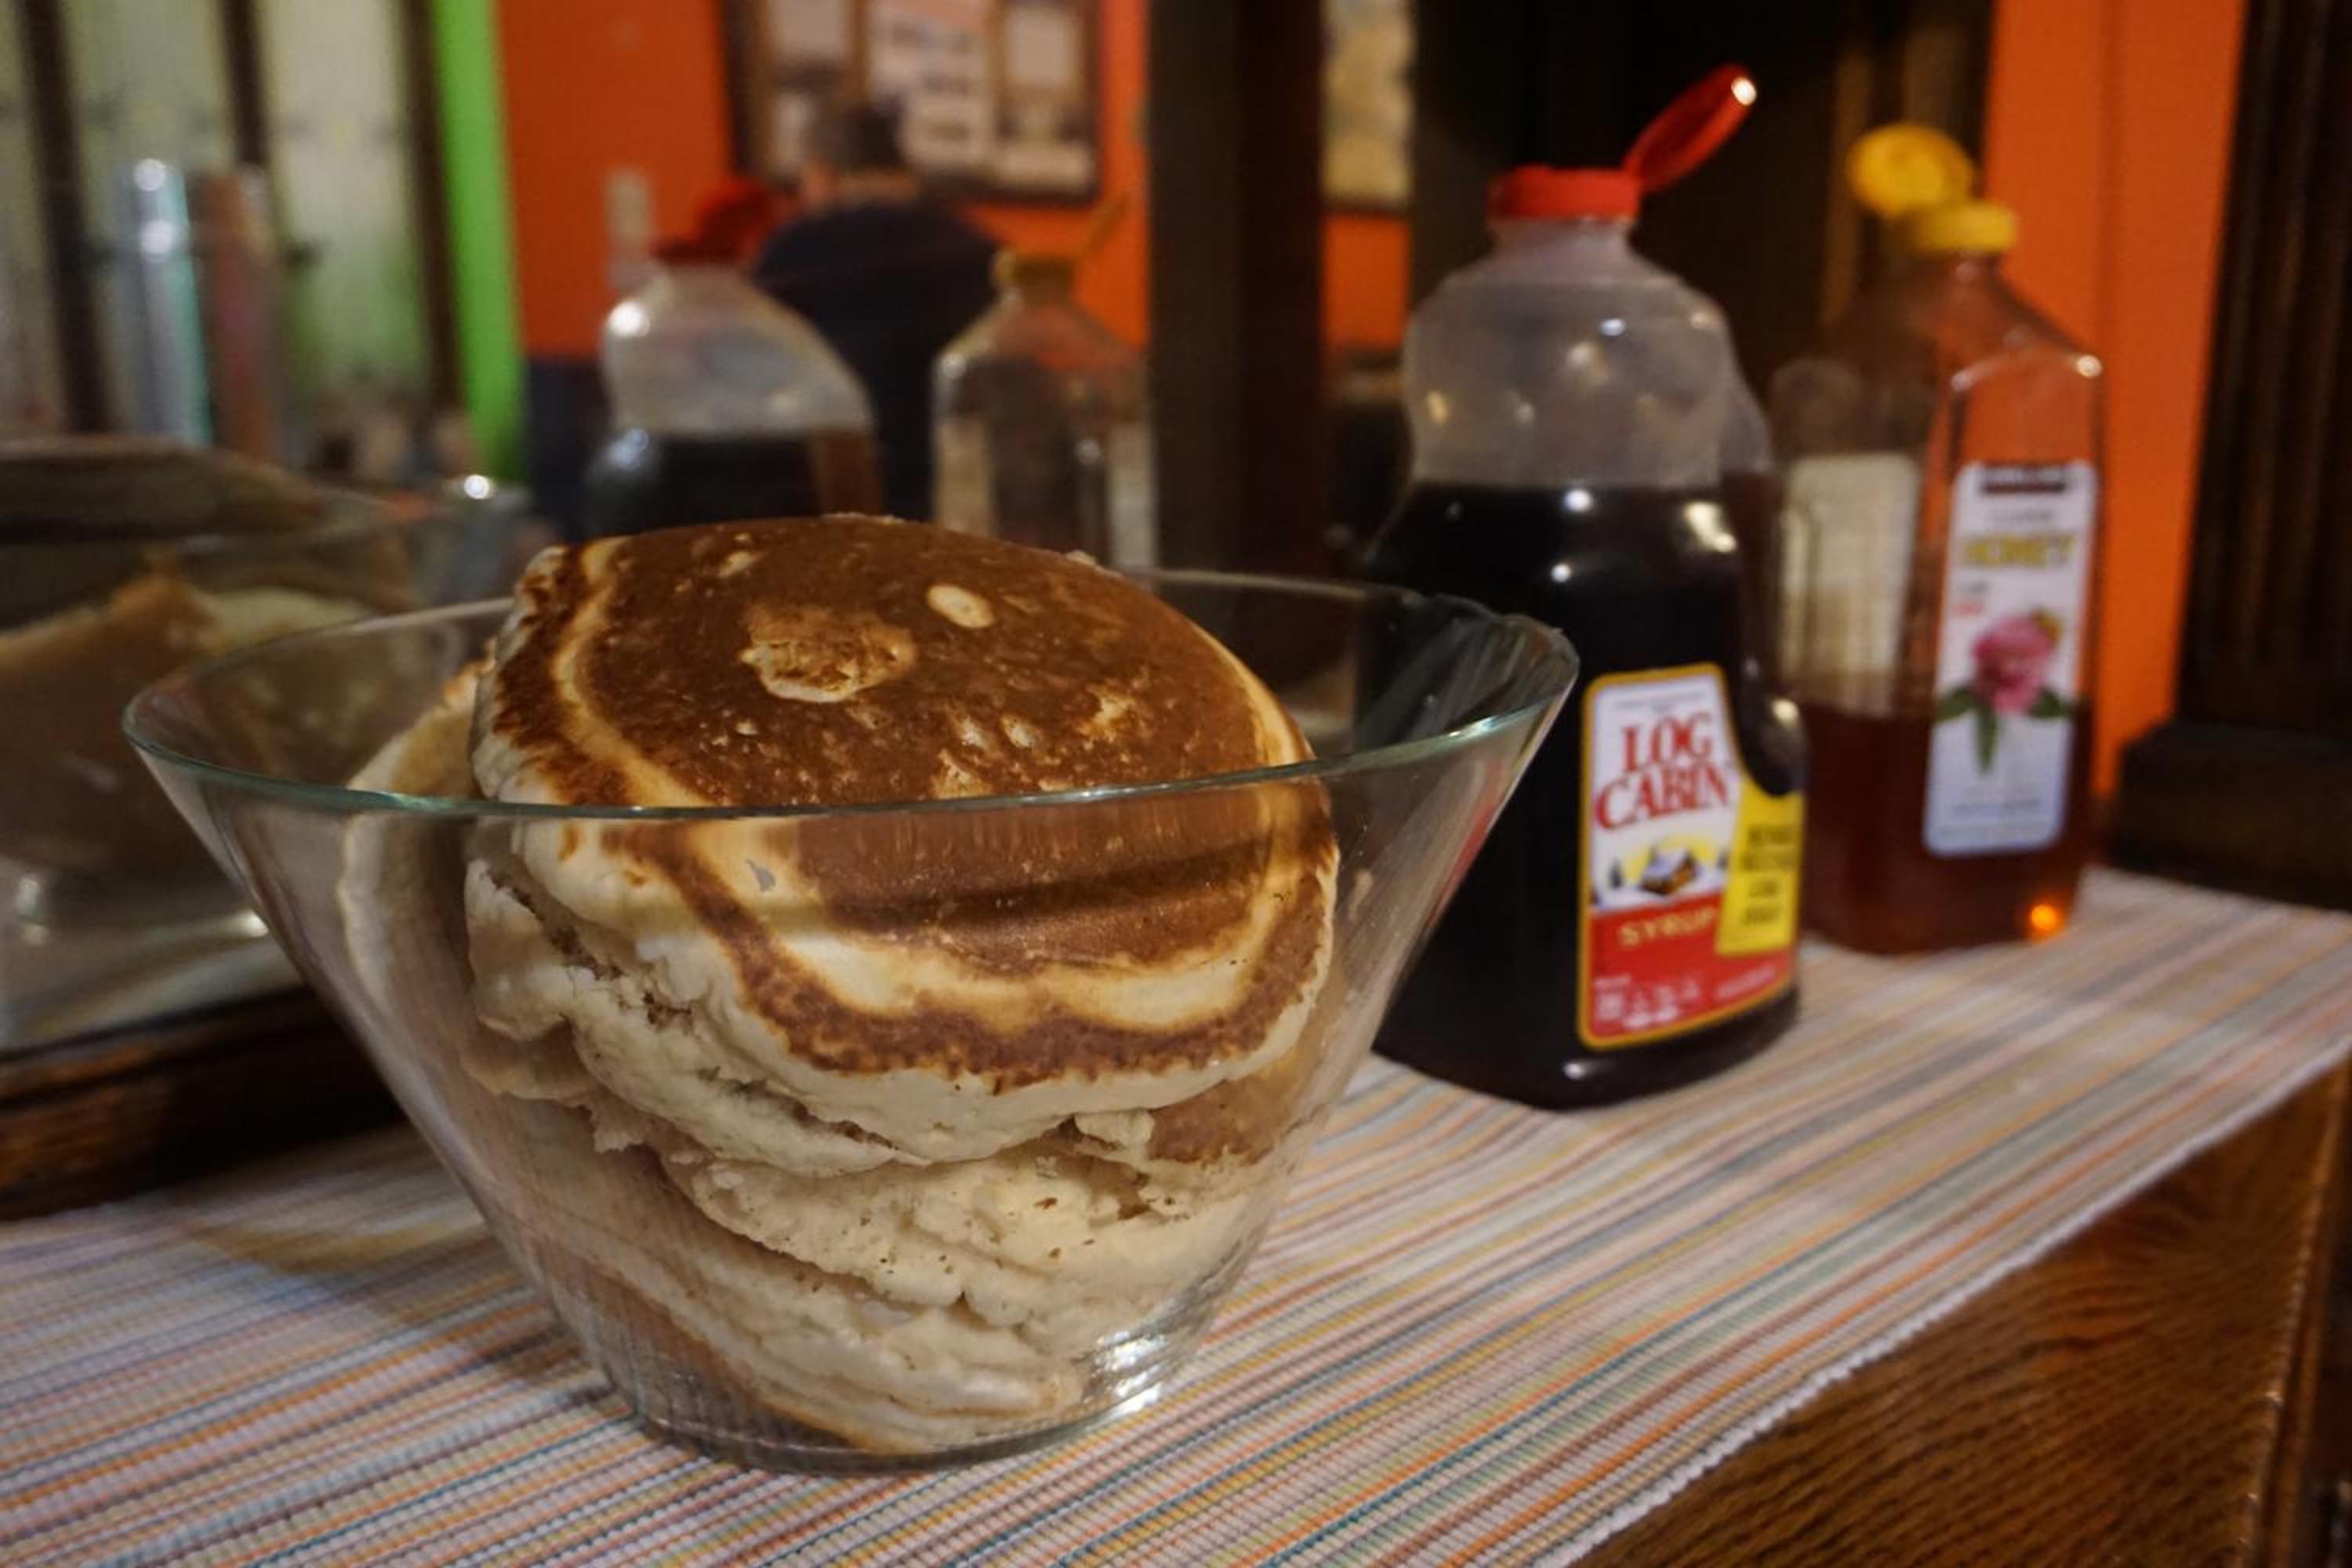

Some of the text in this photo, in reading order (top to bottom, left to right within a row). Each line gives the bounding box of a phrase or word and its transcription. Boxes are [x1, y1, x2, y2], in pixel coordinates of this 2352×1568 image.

[1621, 711, 1712, 774] LOG
[1595, 759, 1730, 829] CABIN
[1619, 907, 1717, 946] SYRUP
